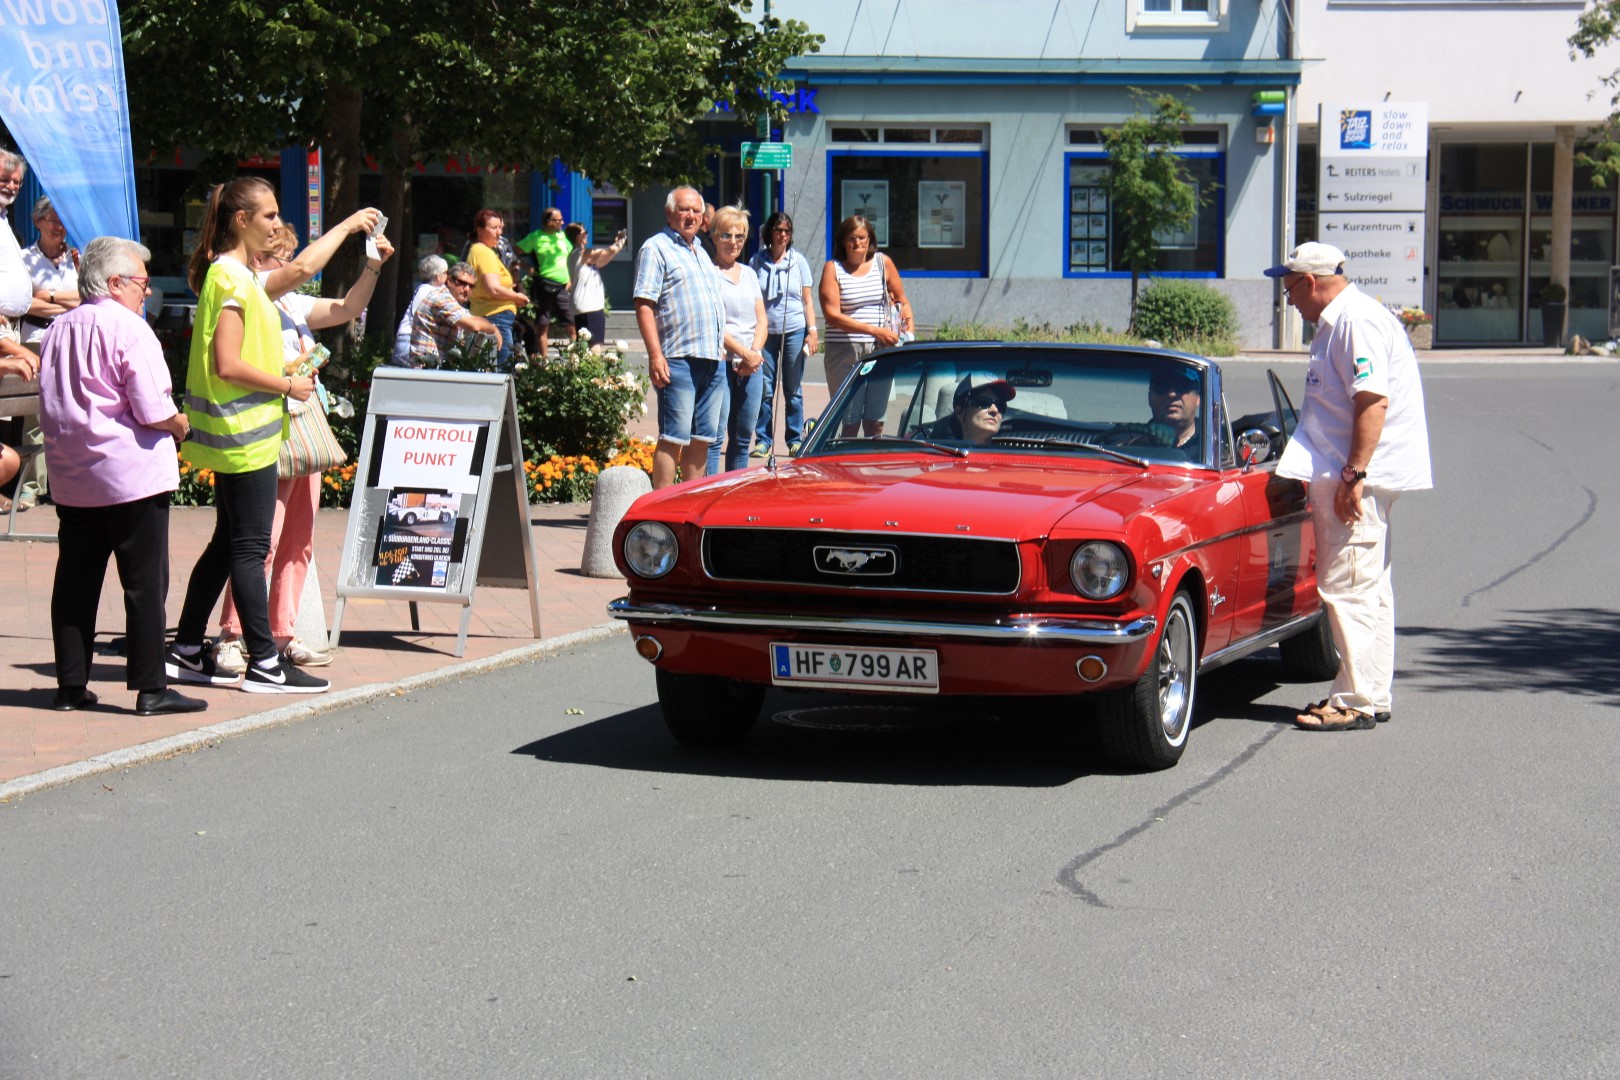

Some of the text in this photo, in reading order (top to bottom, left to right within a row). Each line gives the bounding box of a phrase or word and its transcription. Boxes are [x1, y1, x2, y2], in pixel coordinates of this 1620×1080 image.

[1383, 109, 1408, 120] slow
[1382, 120, 1412, 130] down
[1382, 130, 1403, 140] and
[1382, 141, 1409, 151] relax
[1345, 168, 1401, 177] REITERS Hotels
[1344, 192, 1393, 204] Sulzriegel
[1535, 195, 1611, 210] WNER
[1343, 222, 1402, 232] Kurzentrum
[1344, 249, 1392, 260] Apotheke
[1345, 276, 1388, 287] arkplatz
[393, 426, 475, 443] KONTROLL
[403, 451, 457, 467] PUNKT
[780, 651, 928, 680] A HF 799 AR
